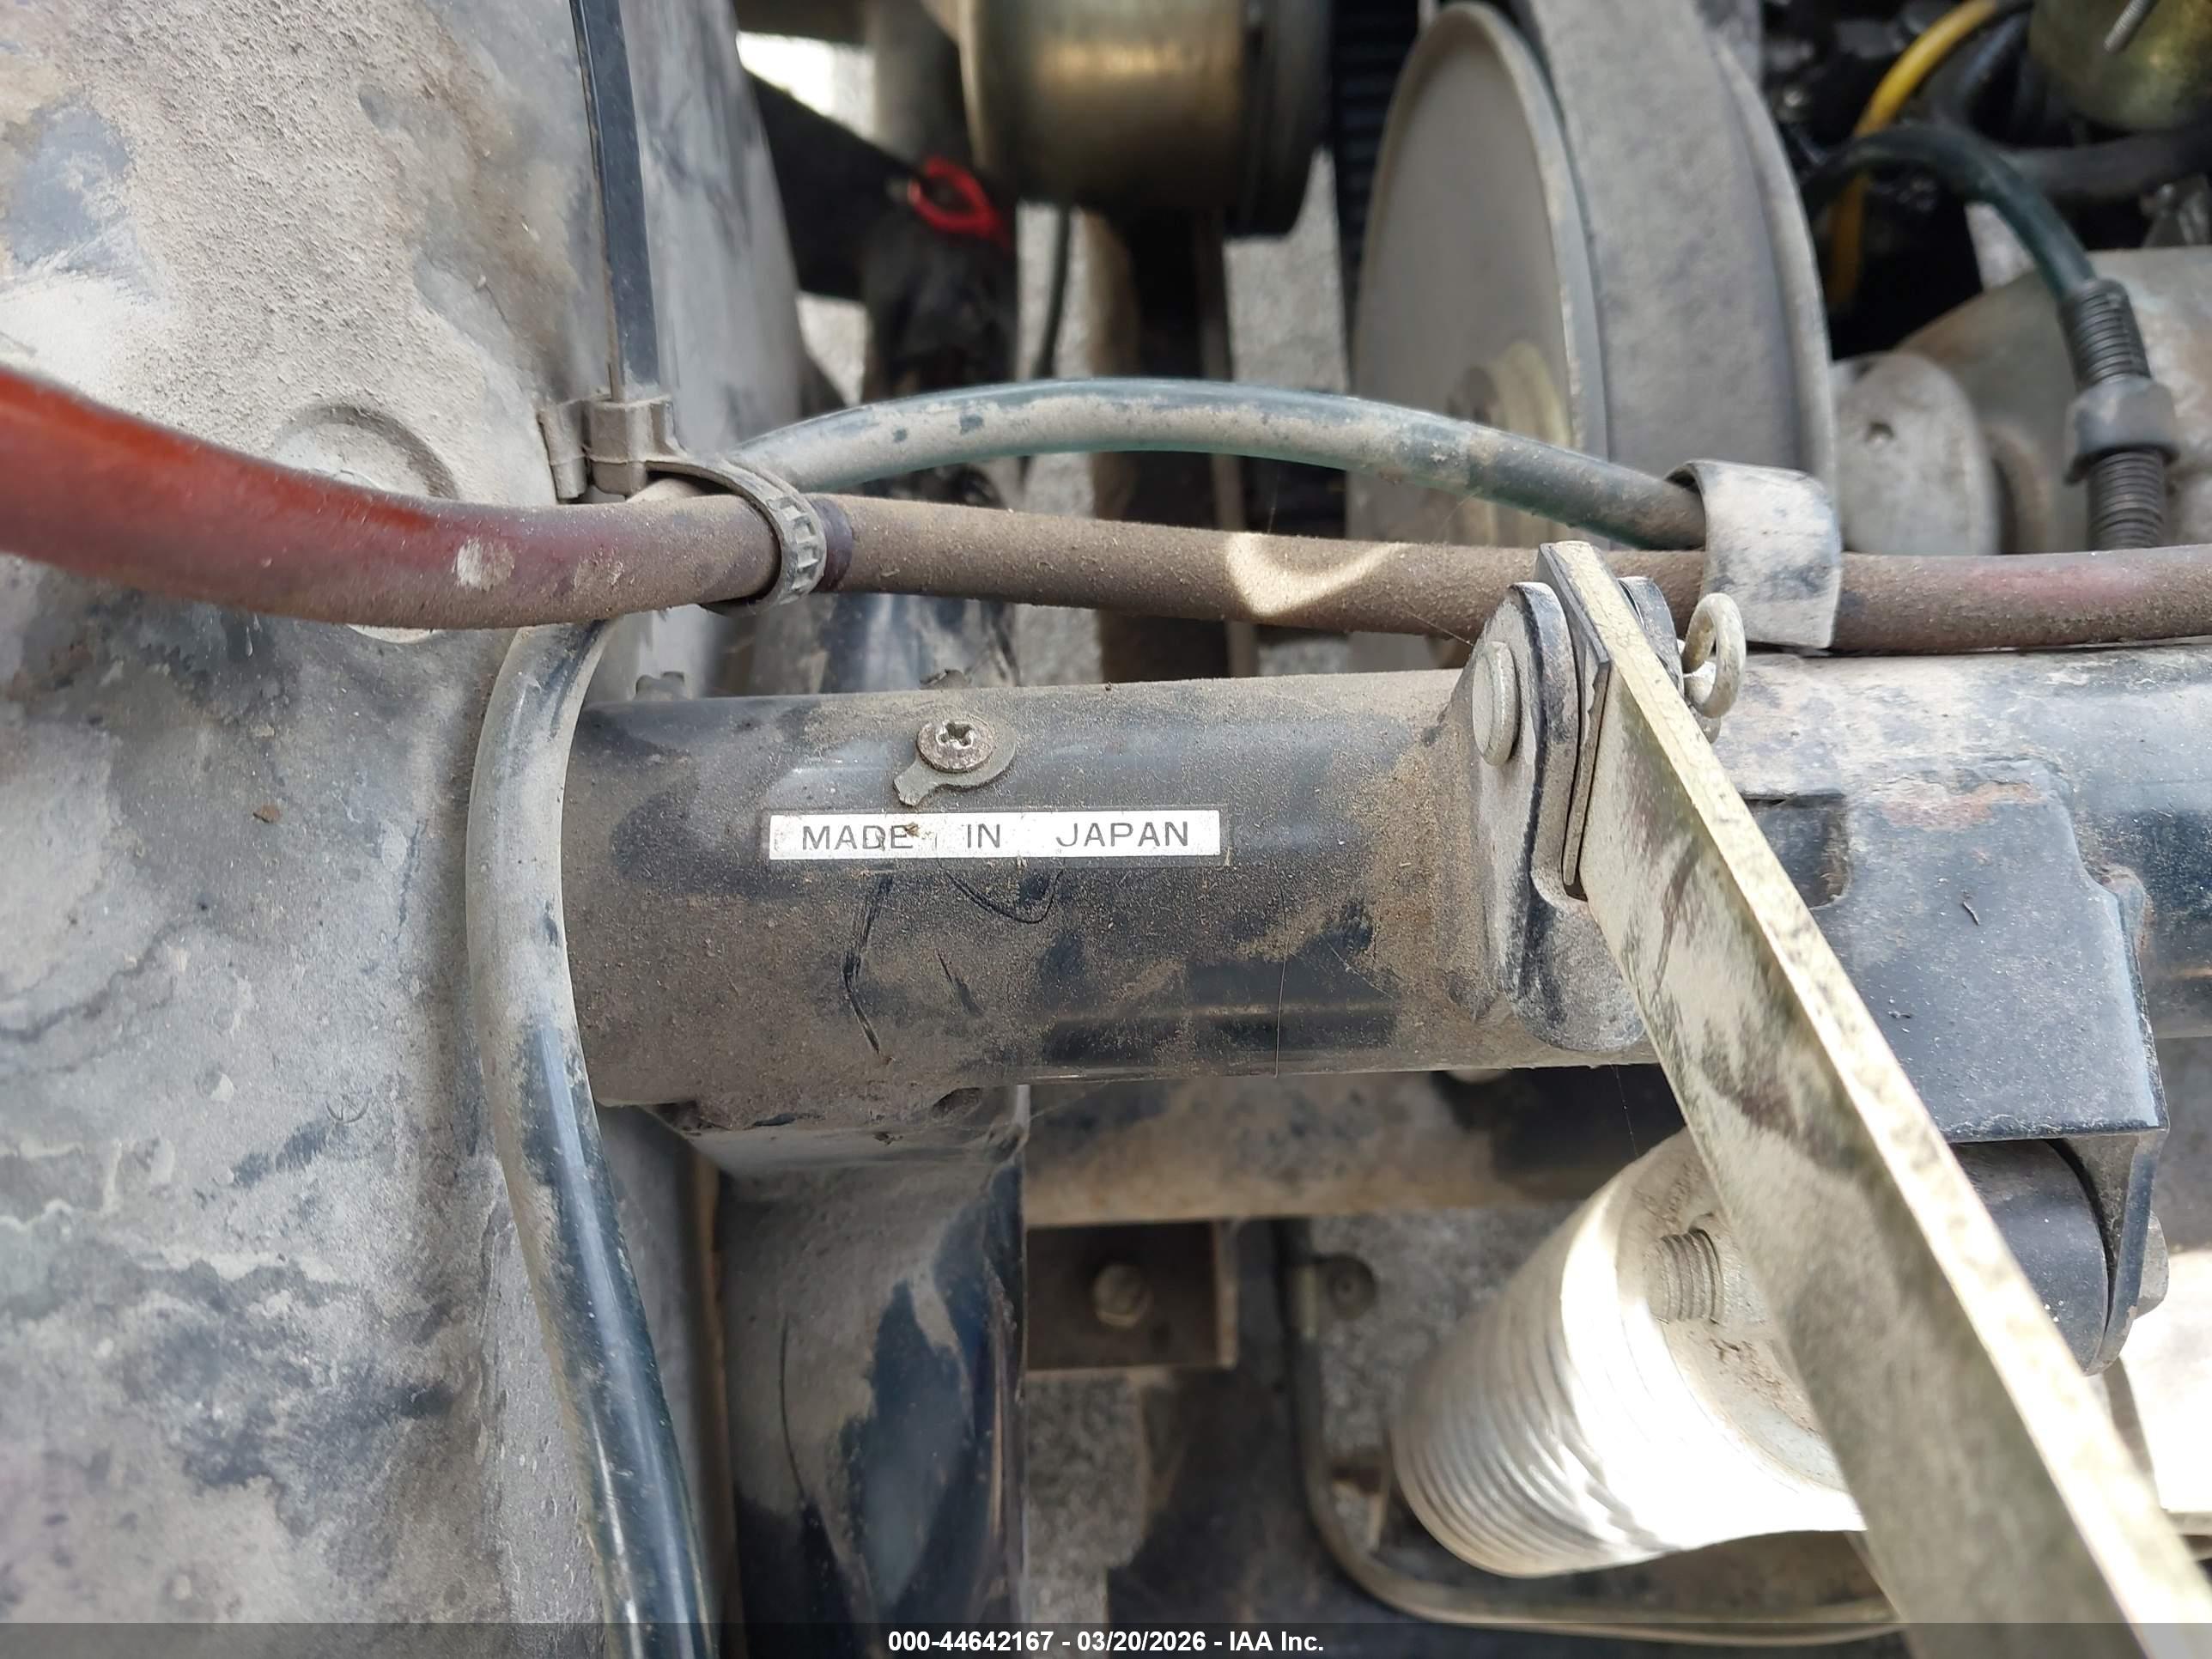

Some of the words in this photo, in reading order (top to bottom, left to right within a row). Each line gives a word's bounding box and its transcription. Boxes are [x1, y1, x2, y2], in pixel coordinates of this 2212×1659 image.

[801, 824, 914, 851] MADE
[967, 823, 1001, 848] IN
[1055, 821, 1189, 848] JAPAN
